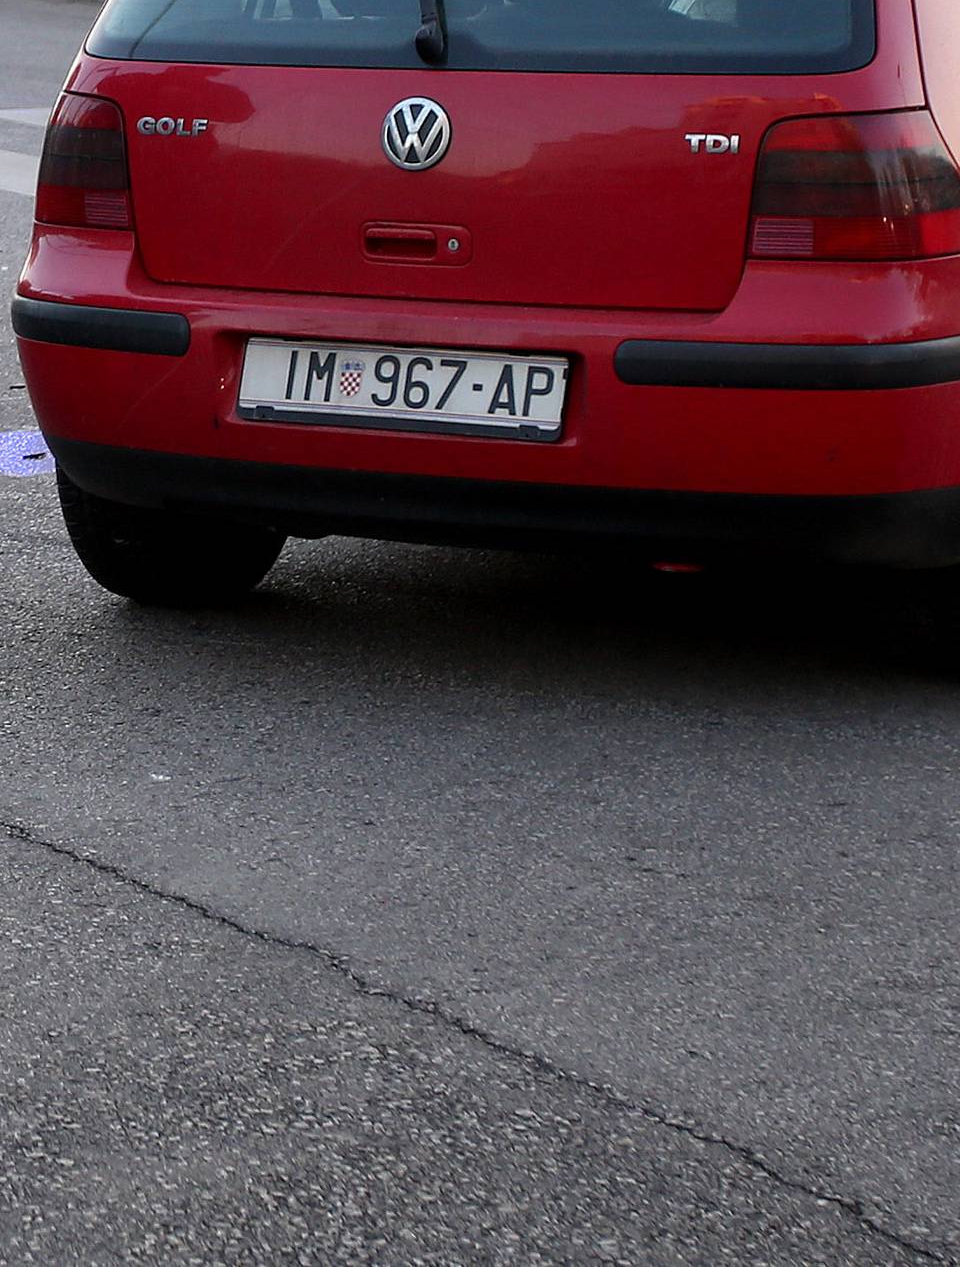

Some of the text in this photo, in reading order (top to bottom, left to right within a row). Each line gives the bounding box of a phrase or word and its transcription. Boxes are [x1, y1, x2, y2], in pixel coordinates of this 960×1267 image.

[137, 116, 209, 137] GOLF
[684, 133, 740, 154] TDI
[285, 349, 555, 417] IM 967-AP
